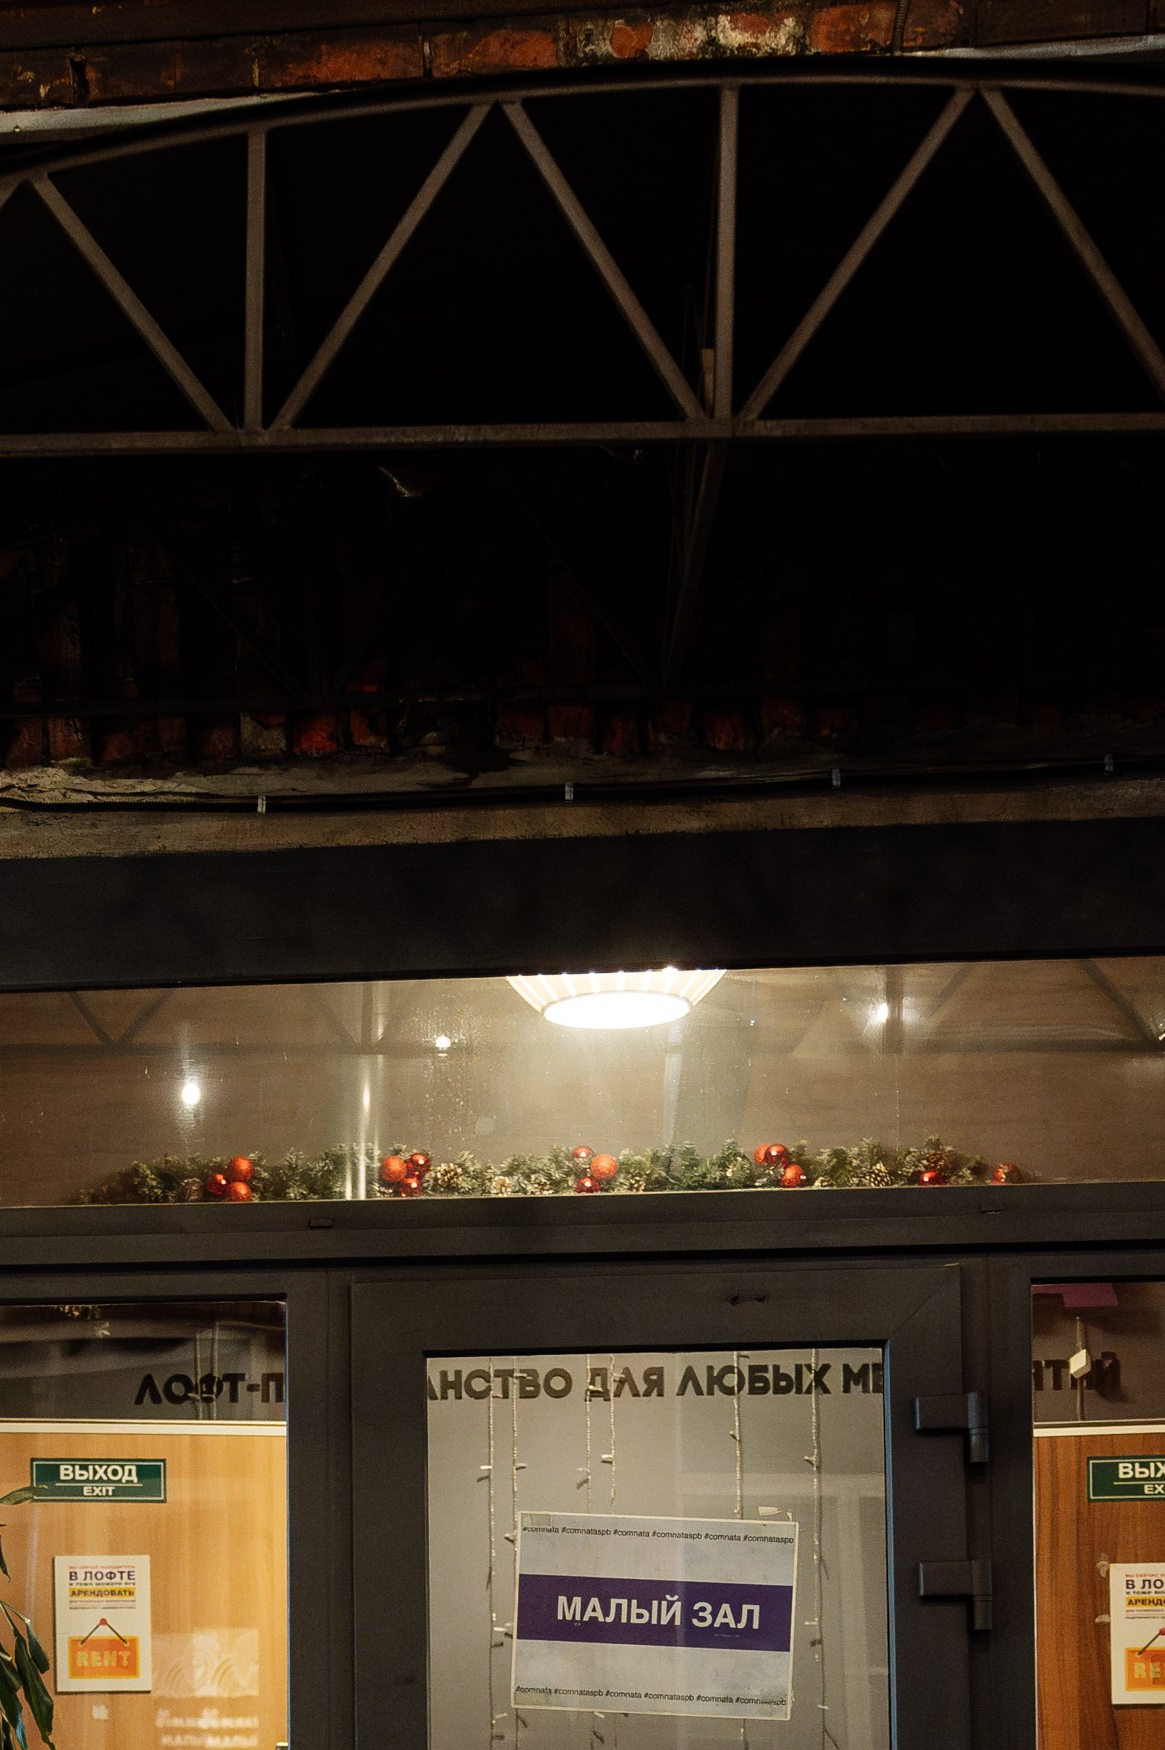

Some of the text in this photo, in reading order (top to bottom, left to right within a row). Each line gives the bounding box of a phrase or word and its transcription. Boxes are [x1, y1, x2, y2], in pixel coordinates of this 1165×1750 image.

[584, 1366, 664, 1402] ДЛЯ
[676, 1363, 832, 1400] ЛЮБЫХ
[59, 1464, 138, 1484] ВЫХОД
[83, 1486, 116, 1496] EXIT
[561, 1526, 611, 1537] #comnataspb
[613, 1528, 650, 1538] #comnata
[651, 1530, 703, 1541] #comnataspb
[704, 1532, 742, 1542] #comnata
[69, 1570, 136, 1582] В ЛОФТЕ
[1125, 1579, 1136, 1590] В
[70, 1589, 135, 1598] АРЕНДОВАТЬ
[1127, 1598, 1165, 1607] АРЕНД
[557, 1595, 760, 1630] МАЛЫЙ ЗАЛ
[76, 1651, 131, 1667] RENT
[554, 1687, 604, 1698] #comnataspb
[605, 1689, 642, 1699] #comnata
[644, 1691, 695, 1702] #comnataspb
[696, 1694, 734, 1704] #comnata
